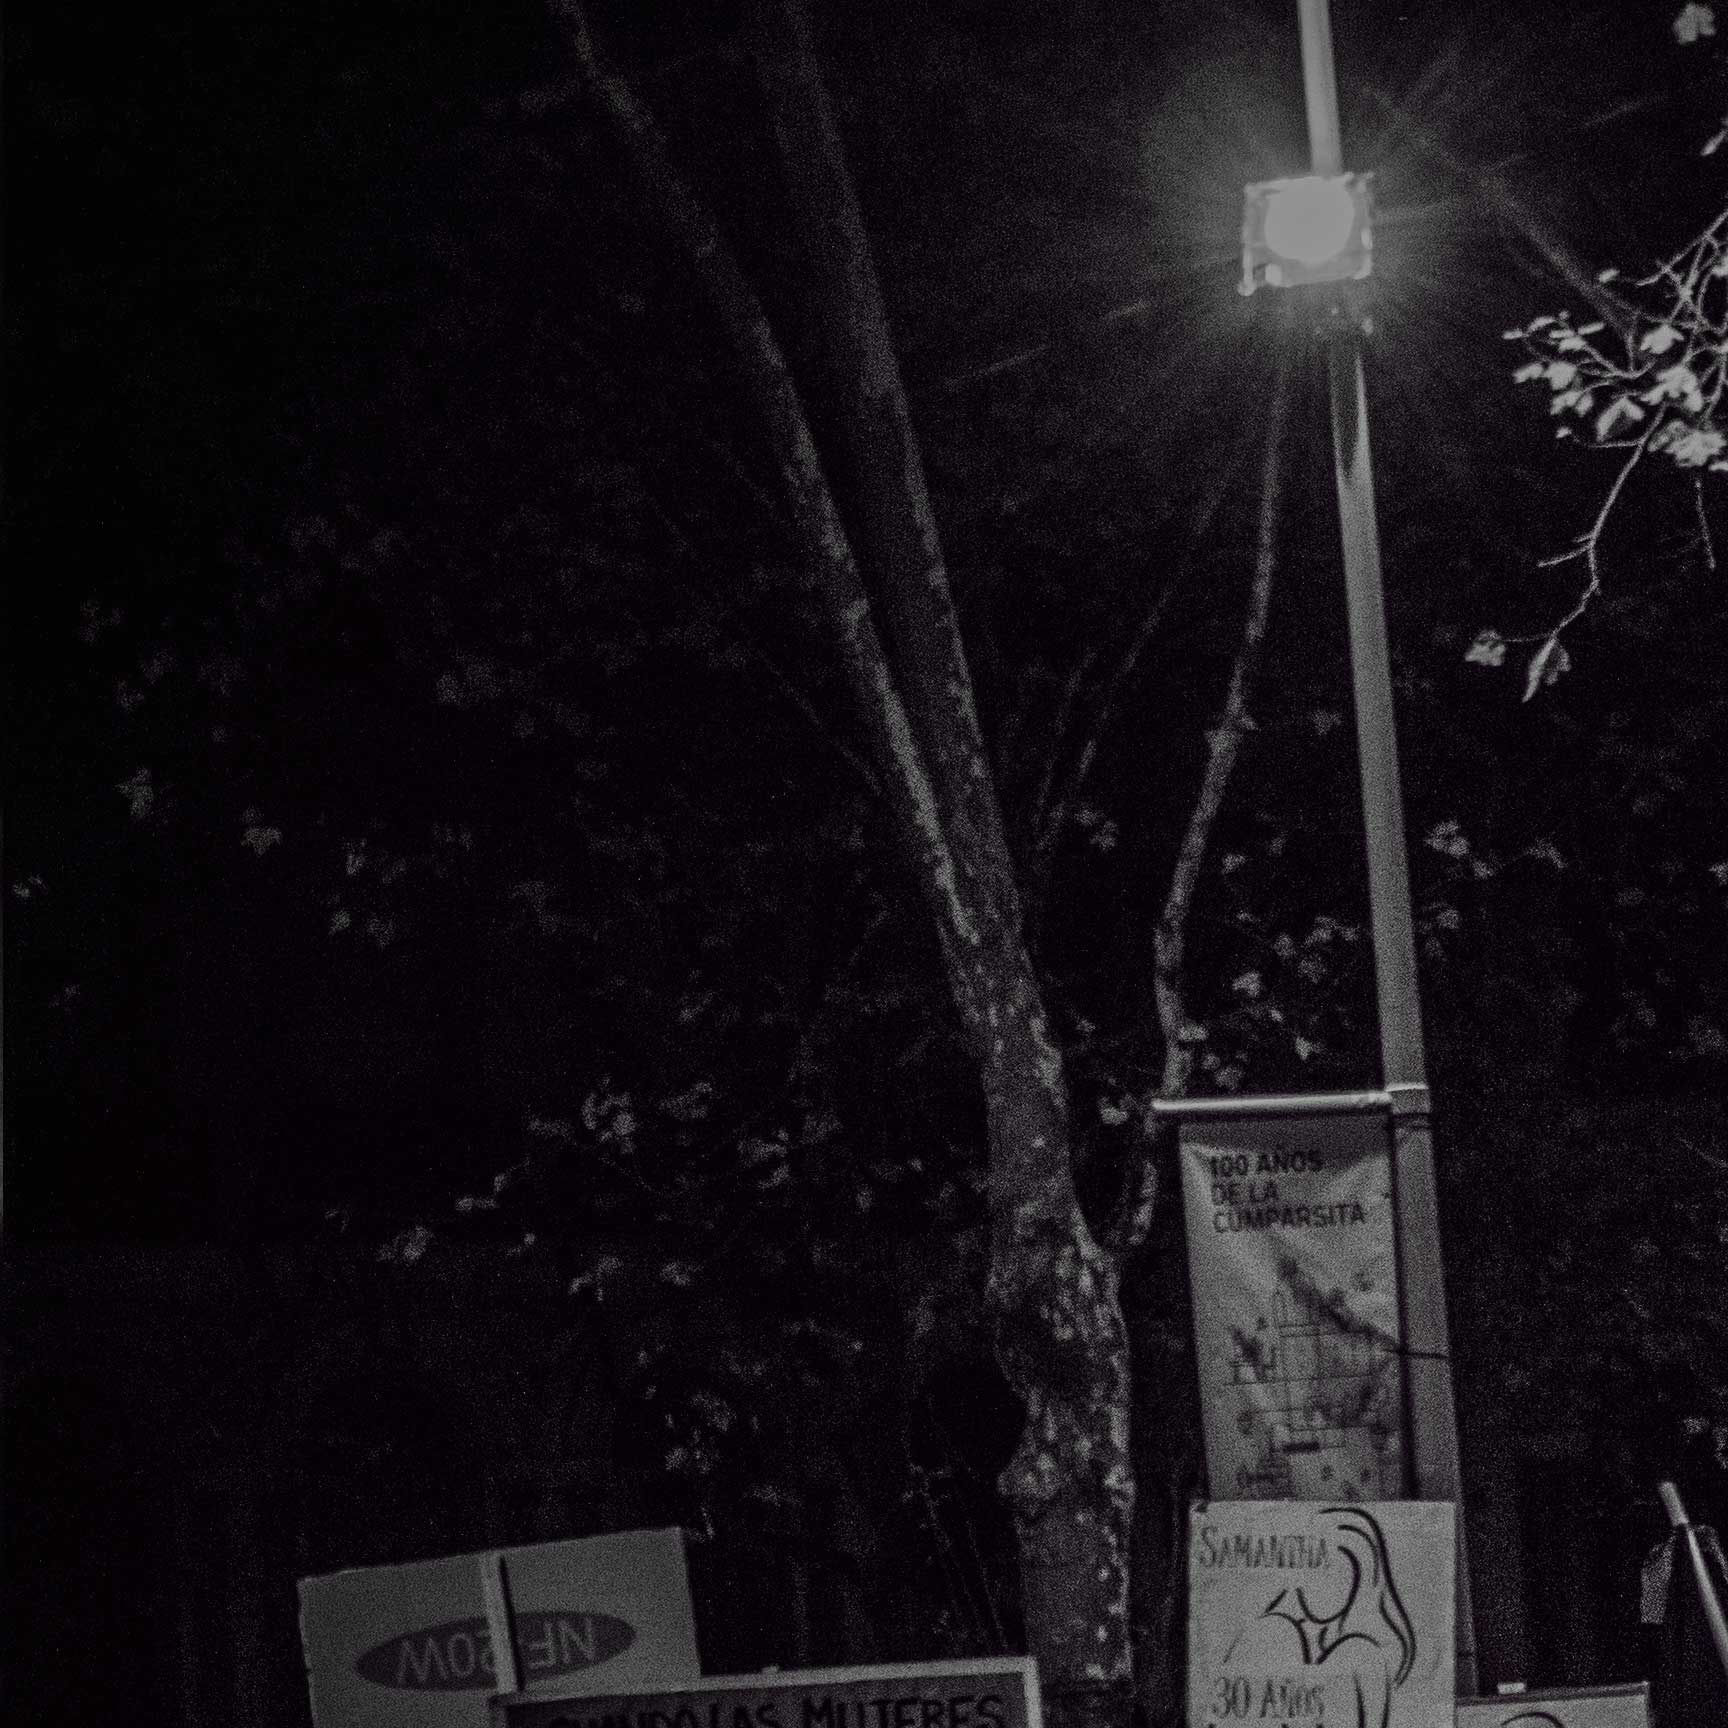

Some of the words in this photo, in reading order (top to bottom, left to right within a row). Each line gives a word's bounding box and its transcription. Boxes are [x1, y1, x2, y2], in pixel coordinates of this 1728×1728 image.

[1210, 1154, 1249, 1178] 100
[1257, 1146, 1324, 1175] AÑOS
[1211, 1183, 1242, 1207] DE
[1249, 1180, 1280, 1204] LA
[1199, 1525, 1333, 1570] SAMANTHA
[1213, 1676, 1252, 1719] 30
[1259, 1676, 1326, 1720] AÑOS
